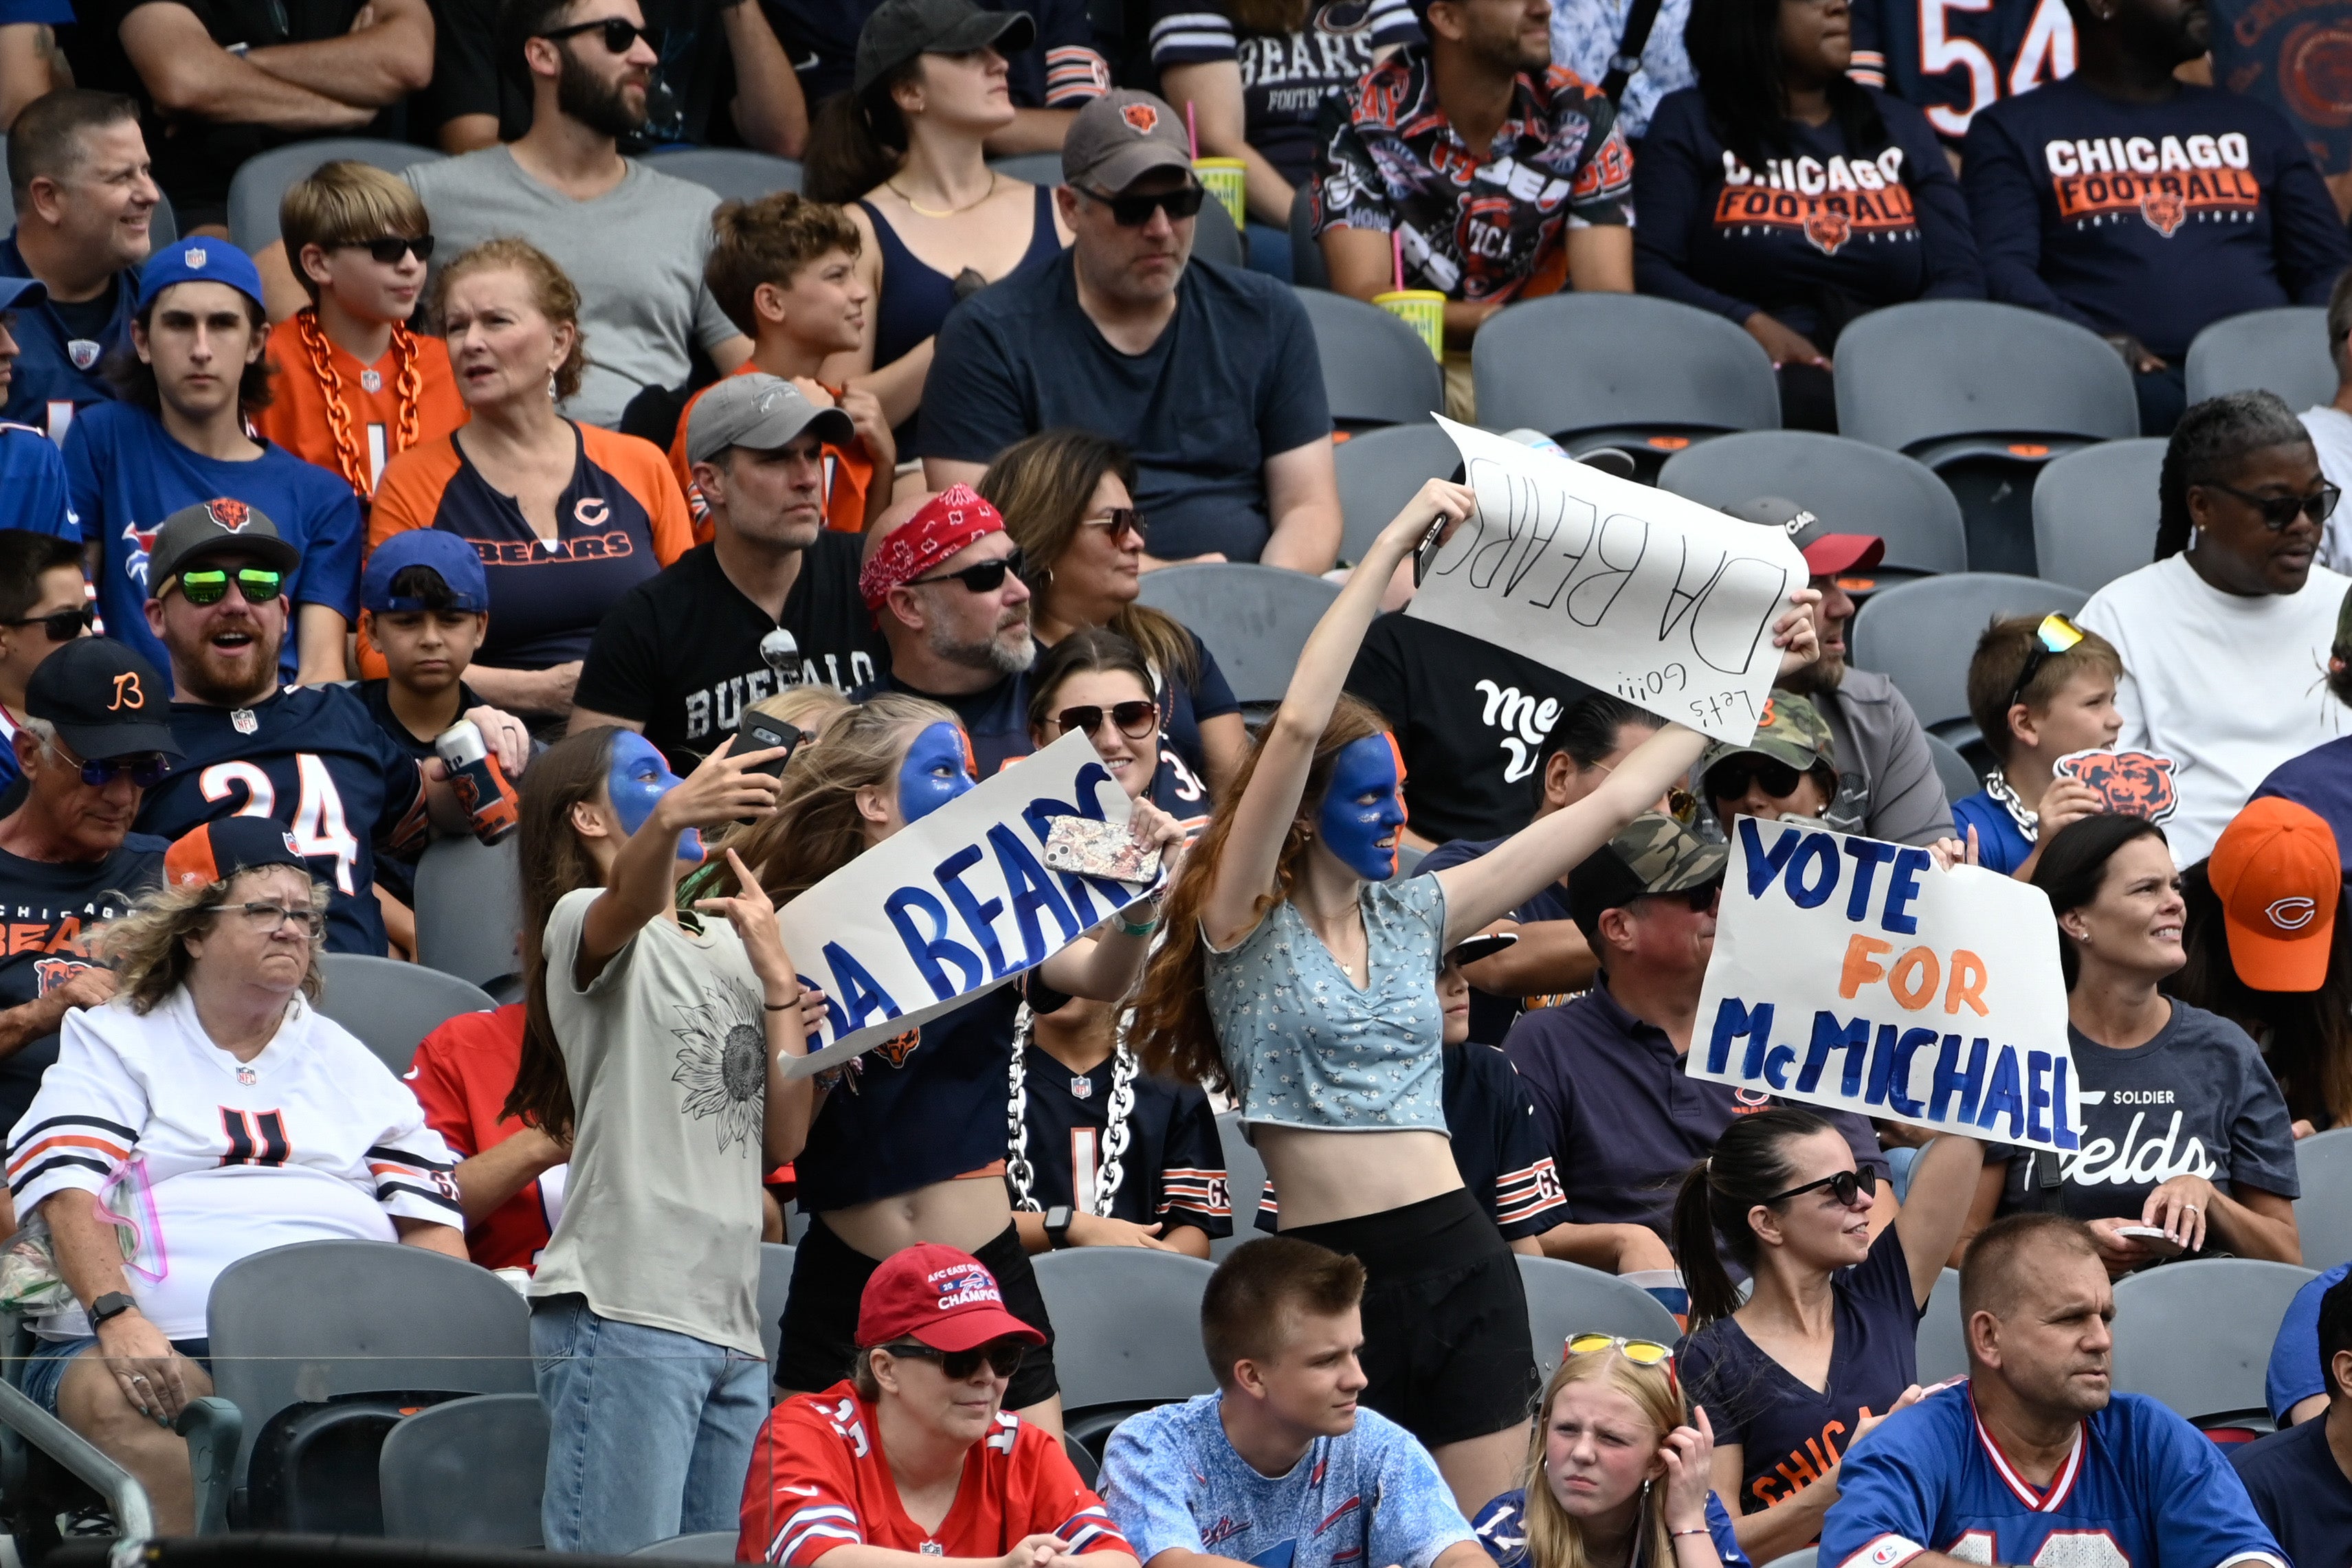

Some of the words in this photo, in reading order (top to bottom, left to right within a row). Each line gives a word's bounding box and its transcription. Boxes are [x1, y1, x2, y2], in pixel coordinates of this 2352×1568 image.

[1918, 0, 2079, 137] 54
[2045, 132, 2249, 177] CHICAGO
[2063, 172, 2255, 208] FOOTBALL
[575, 497, 609, 526] C
[465, 530, 634, 566] BEARS
[1436, 457, 1652, 627] BEARS
[1658, 534, 1788, 676] DA
[107, 671, 144, 711] B
[1689, 689, 1757, 728] Let's
[236, 719, 255, 730] NFL
[199, 752, 359, 897] 24
[1738, 817, 1931, 935] VOTE
[2265, 897, 2315, 930] C
[795, 940, 904, 1055] DA
[1839, 934, 1990, 1018] FOR
[238, 1074, 256, 1084] NFL
[1706, 997, 2079, 1152] McMICHAEL
[2114, 1090, 2175, 1105] SOLDIER
[217, 1105, 291, 1168] 11
[2041, 1102, 2217, 1187] elds
[928, 1270, 948, 1283] AFC
[945, 1264, 968, 1276] EAST
[1753, 1406, 1873, 1508] CHIC
